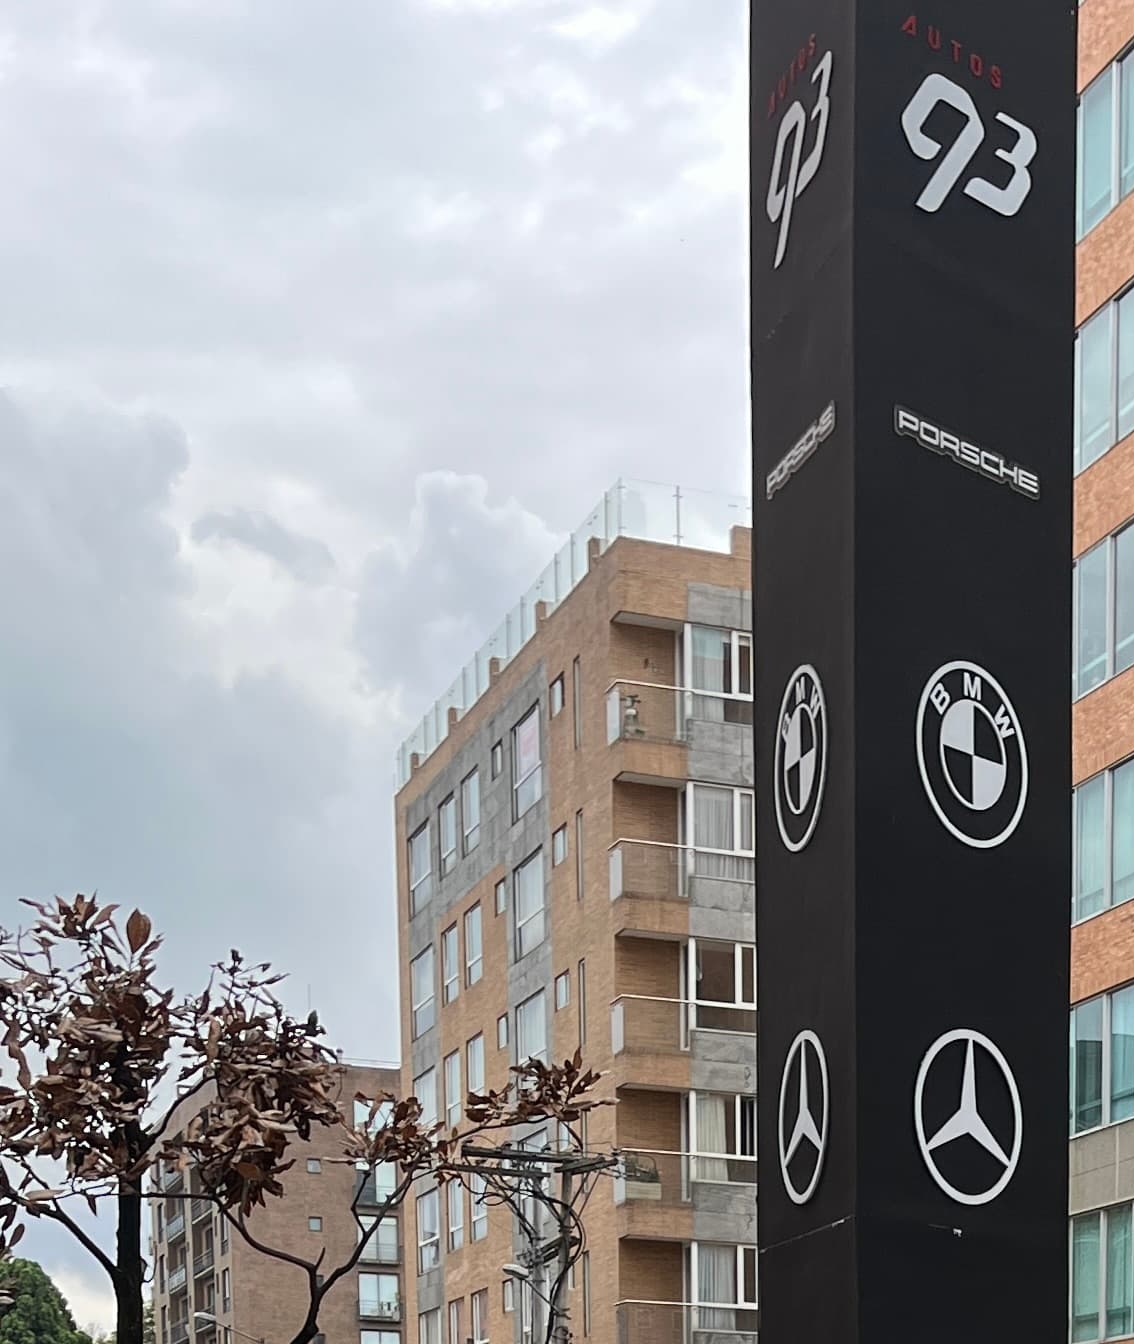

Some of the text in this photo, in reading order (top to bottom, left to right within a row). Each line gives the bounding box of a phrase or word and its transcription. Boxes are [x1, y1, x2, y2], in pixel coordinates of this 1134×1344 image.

[767, 32, 817, 119] AUTOS
[901, 15, 1003, 89] AUTOS
[766, 50, 833, 269] 93
[901, 72, 1038, 217] 93
[766, 404, 834, 496] PORSCHE
[897, 409, 1040, 494] PORSCHE
[781, 675, 822, 742] BMW
[930, 671, 1016, 739] BMW
